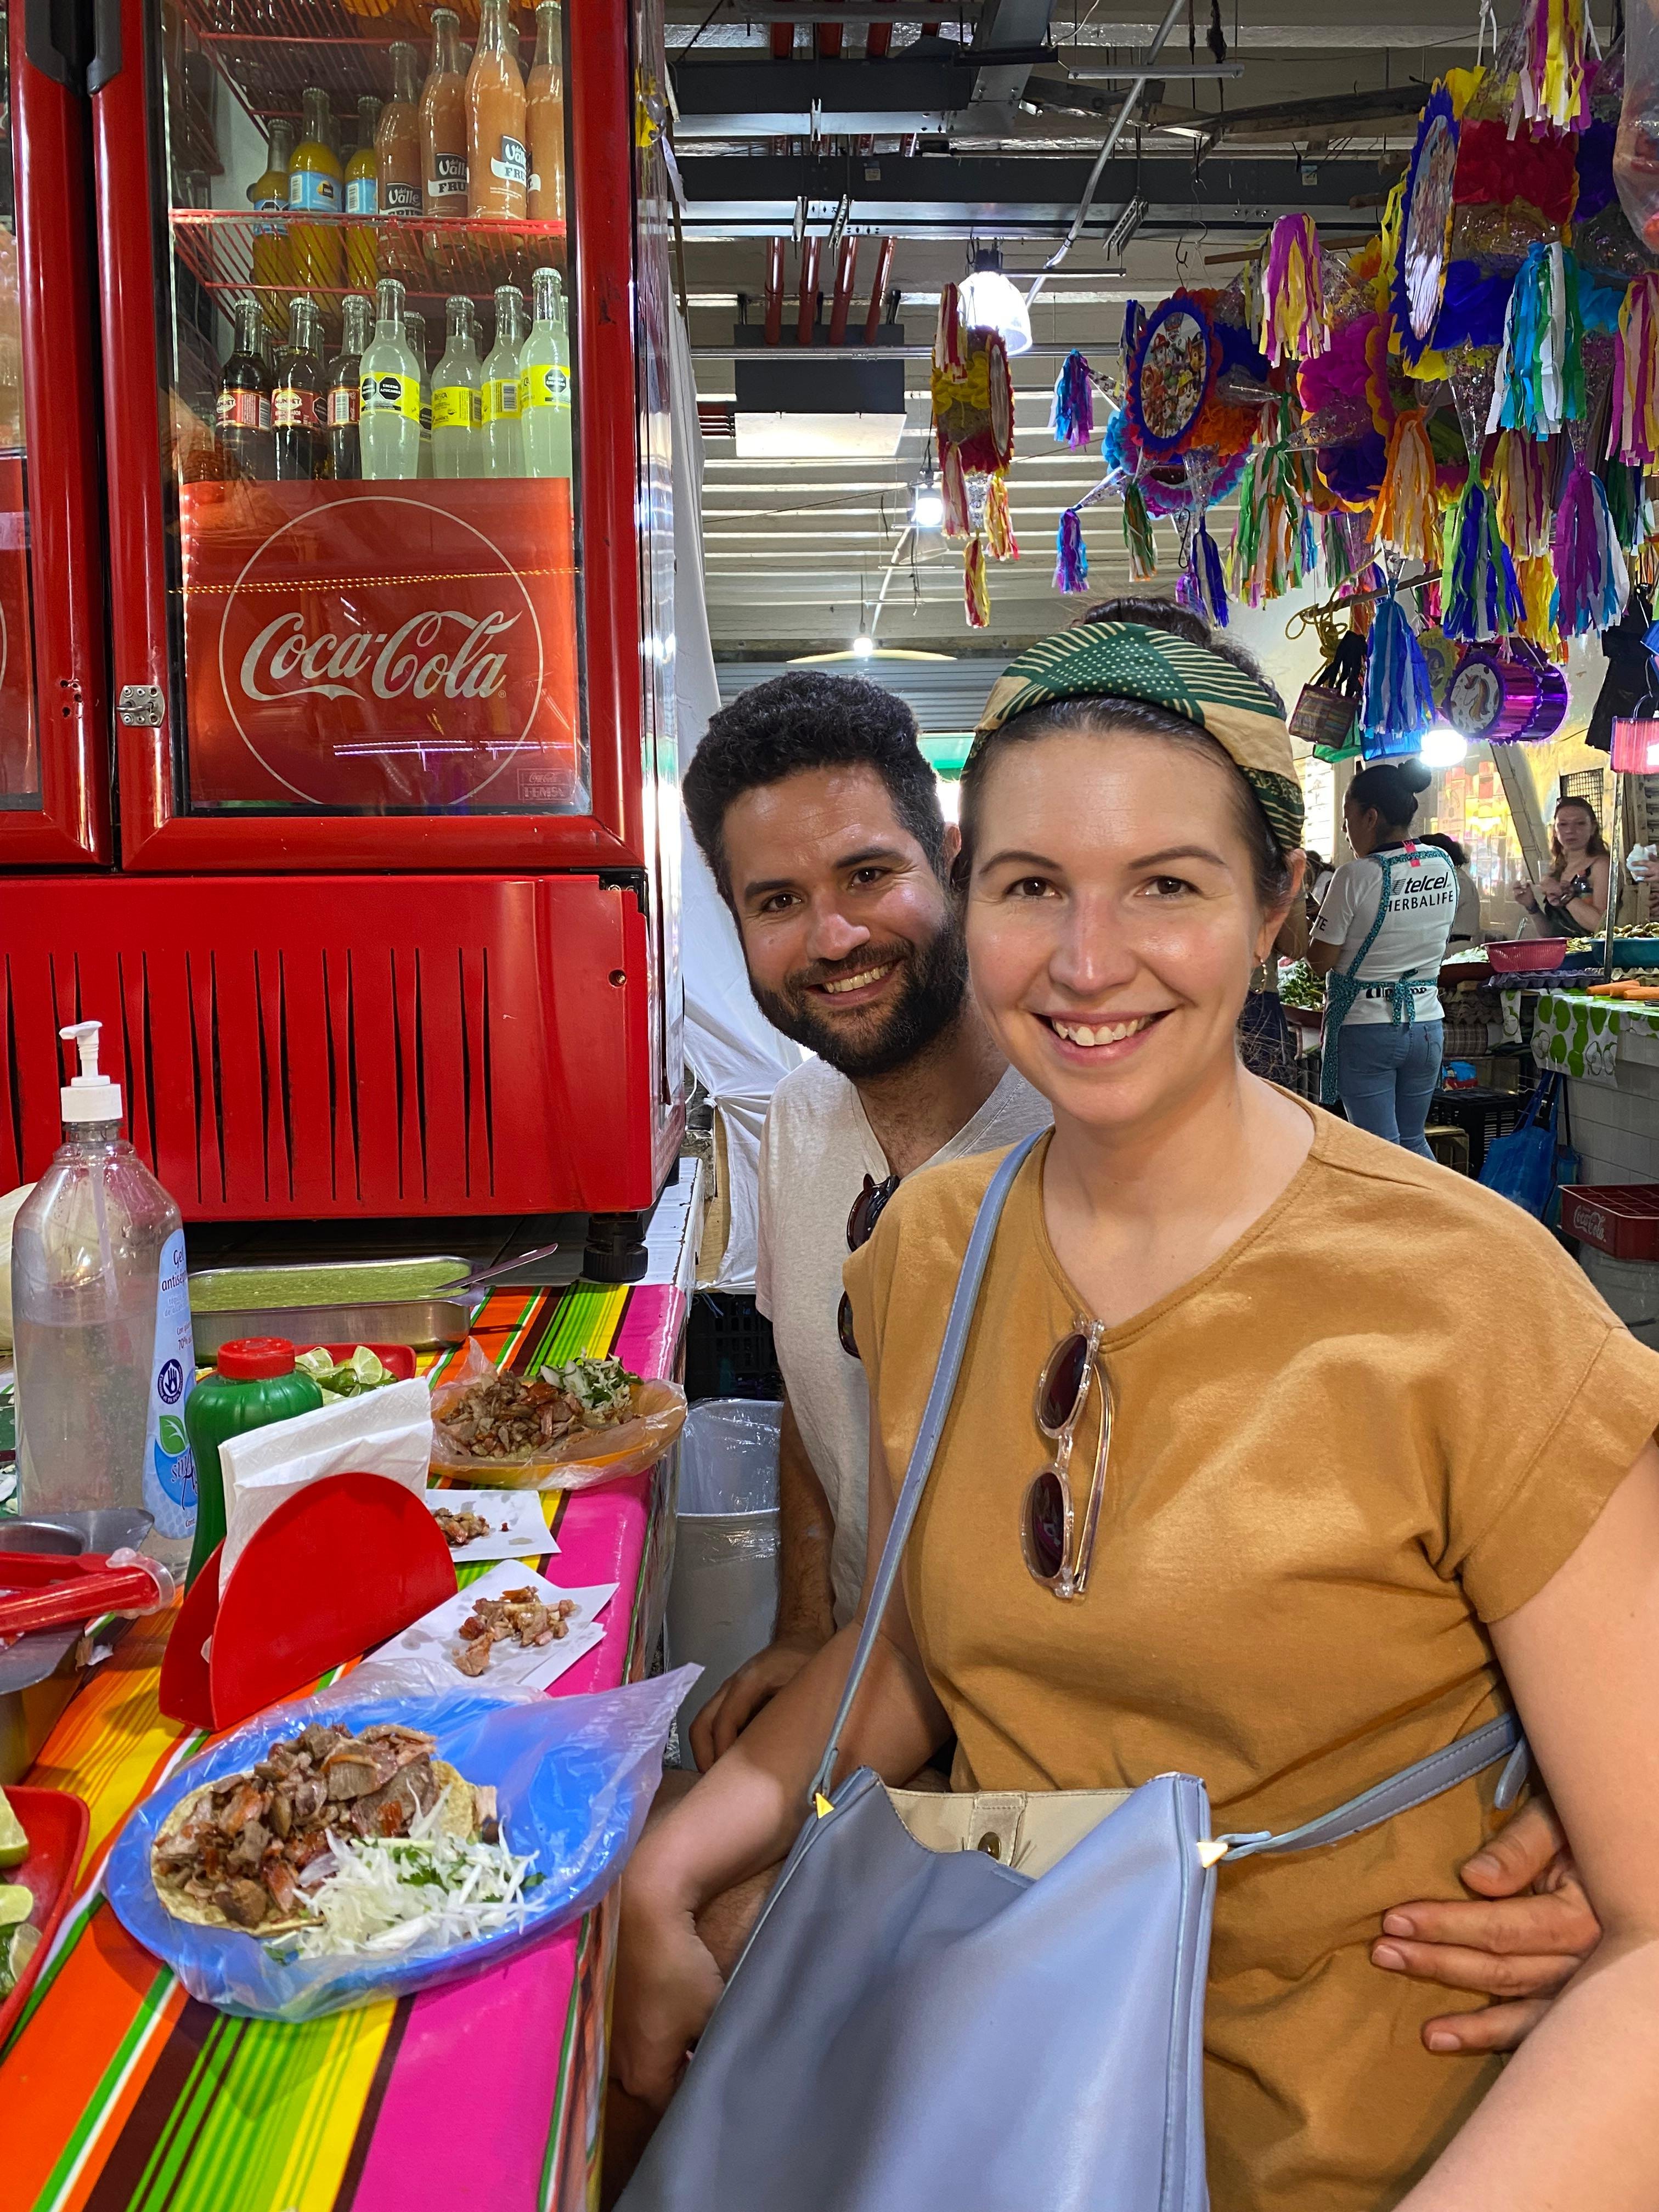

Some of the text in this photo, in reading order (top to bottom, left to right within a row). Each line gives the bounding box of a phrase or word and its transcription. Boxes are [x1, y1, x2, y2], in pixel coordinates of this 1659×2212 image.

[439, 160, 466, 176] Vall
[388, 189, 421, 206] Valle
[240, 610, 522, 701] Coca-Cola
[1404, 872, 1448, 894] telcel
[1388, 891, 1453, 912] HERBALIFE
[173, 1245, 184, 1268] Gel
